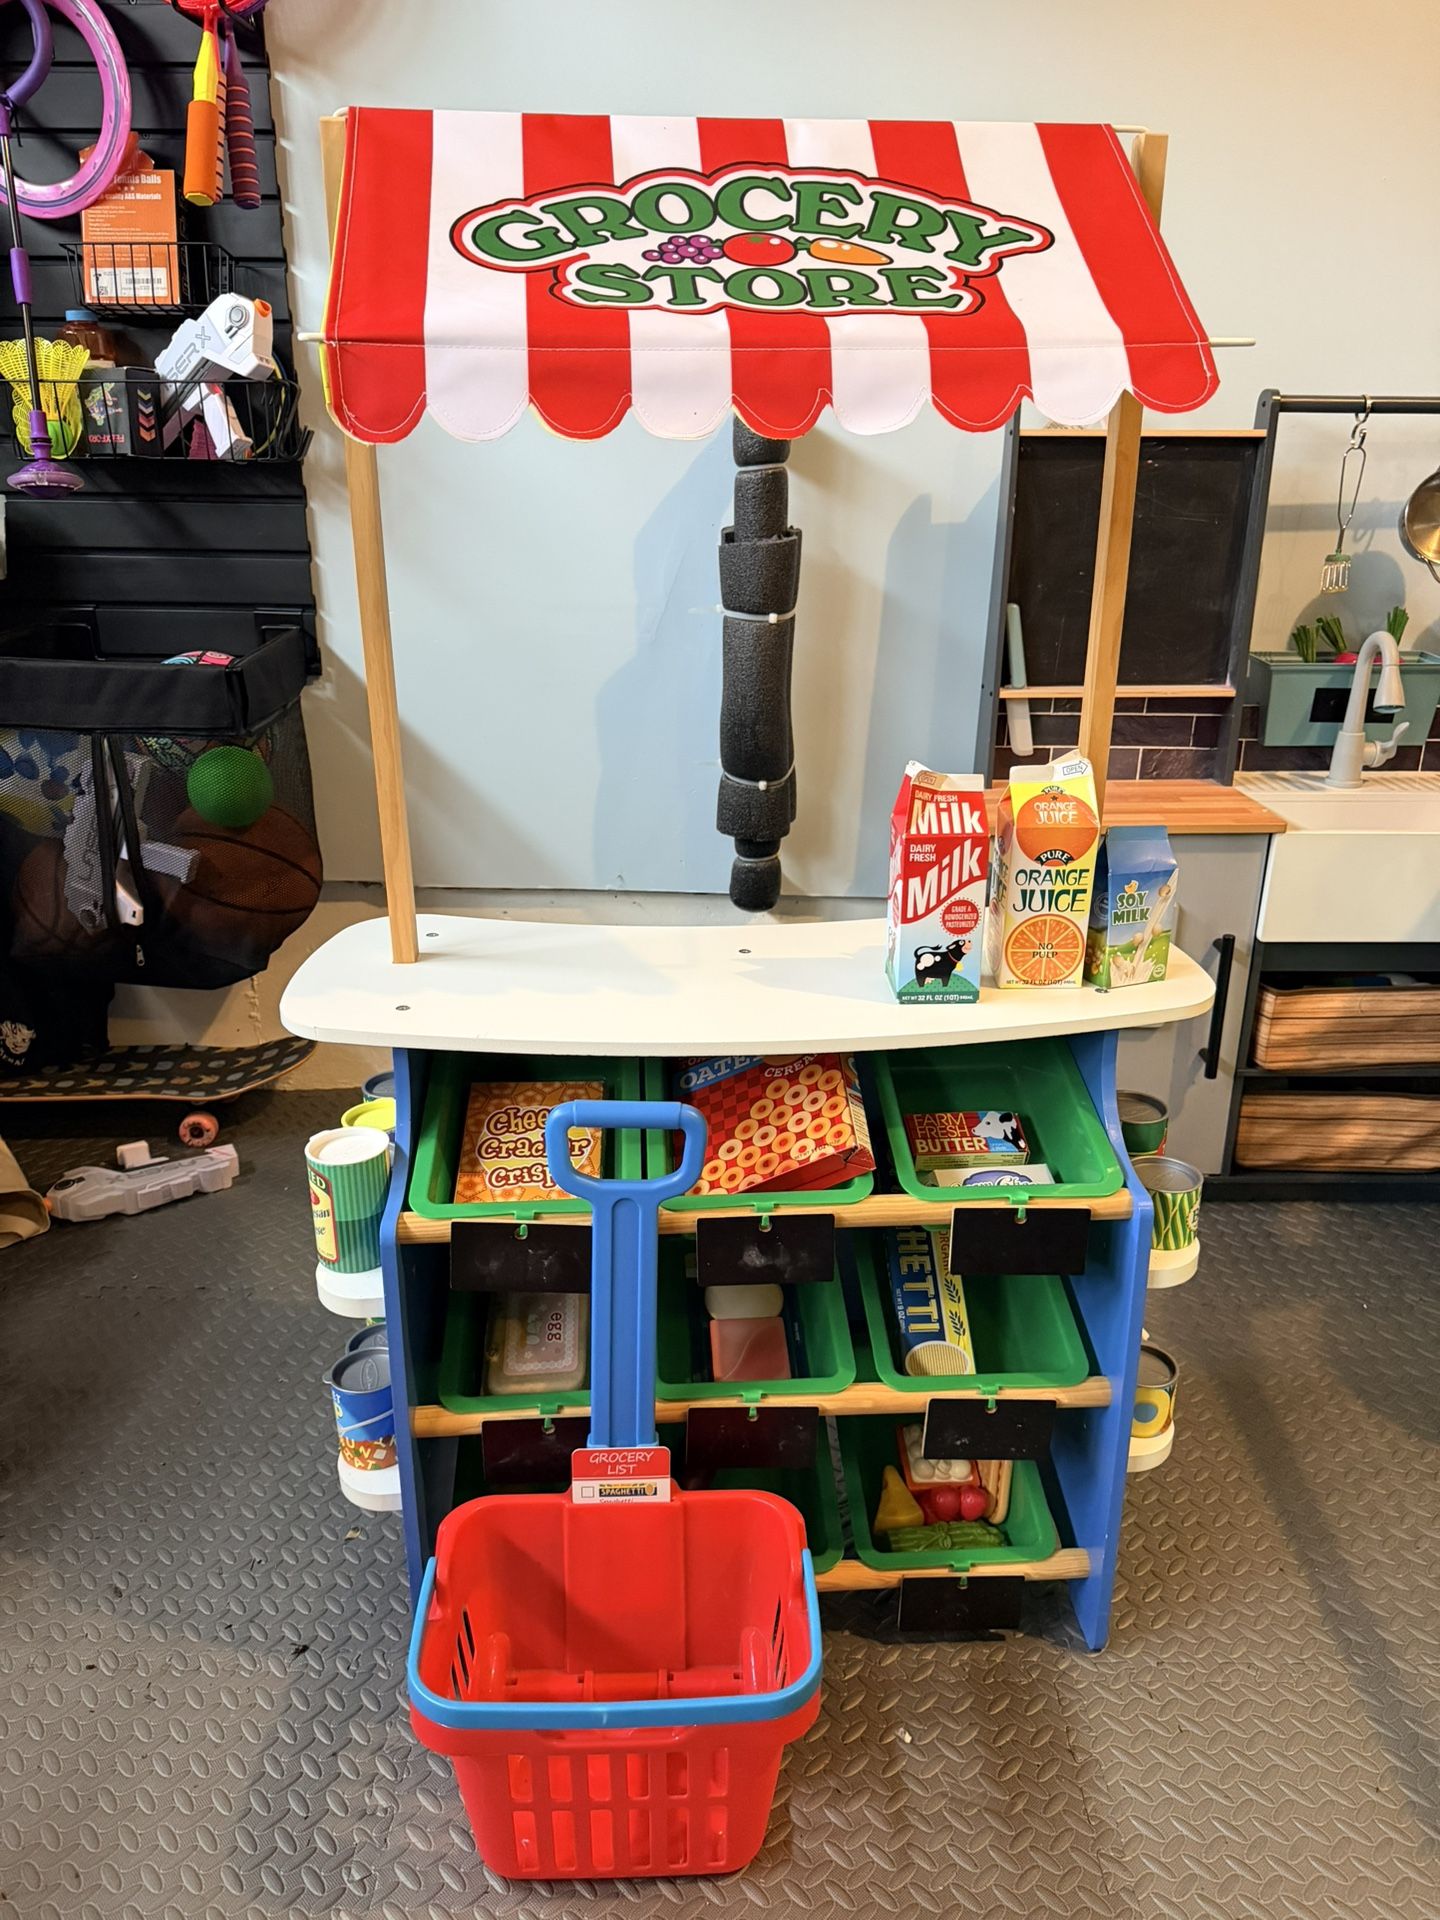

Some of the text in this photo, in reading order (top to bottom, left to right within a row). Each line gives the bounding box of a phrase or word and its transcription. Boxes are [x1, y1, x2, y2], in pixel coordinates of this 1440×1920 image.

[141, 174, 161, 184] Balls
[471, 176, 1035, 267] GROCERY
[570, 262, 967, 308] STORE
[194, 325, 212, 349] X
[1065, 764, 1083, 775] OPEN
[914, 790, 958, 802] DAIRY FRESH
[1034, 802, 1077, 812] ORANGE
[910, 798, 984, 835] Milk
[1036, 811, 1079, 825] JUICE
[910, 844, 937, 853] DAIRY
[909, 853, 937, 862] FRESH
[1040, 850, 1070, 864] PURE
[906, 838, 983, 919] Milk
[1015, 868, 1090, 886] ORANGE
[1012, 889, 1088, 912] JUICE
[1117, 891, 1148, 909] SOY
[1112, 908, 1151, 925] MILK
[1032, 951, 1058, 959] PULP
[764, 1054, 818, 1078] CEREA
[913, 1112, 966, 1126] FARM
[916, 1125, 970, 1138] FRESH
[477, 1133, 592, 1160] Cracr
[915, 1137, 988, 1153] BUTTER
[895, 1226, 940, 1333] HETTI
[547, 1312, 562, 1342] egg
[590, 1451, 654, 1464] GROCERY
[607, 1464, 637, 1475] LIST
[600, 1487, 644, 1496] SPAGHETTI
